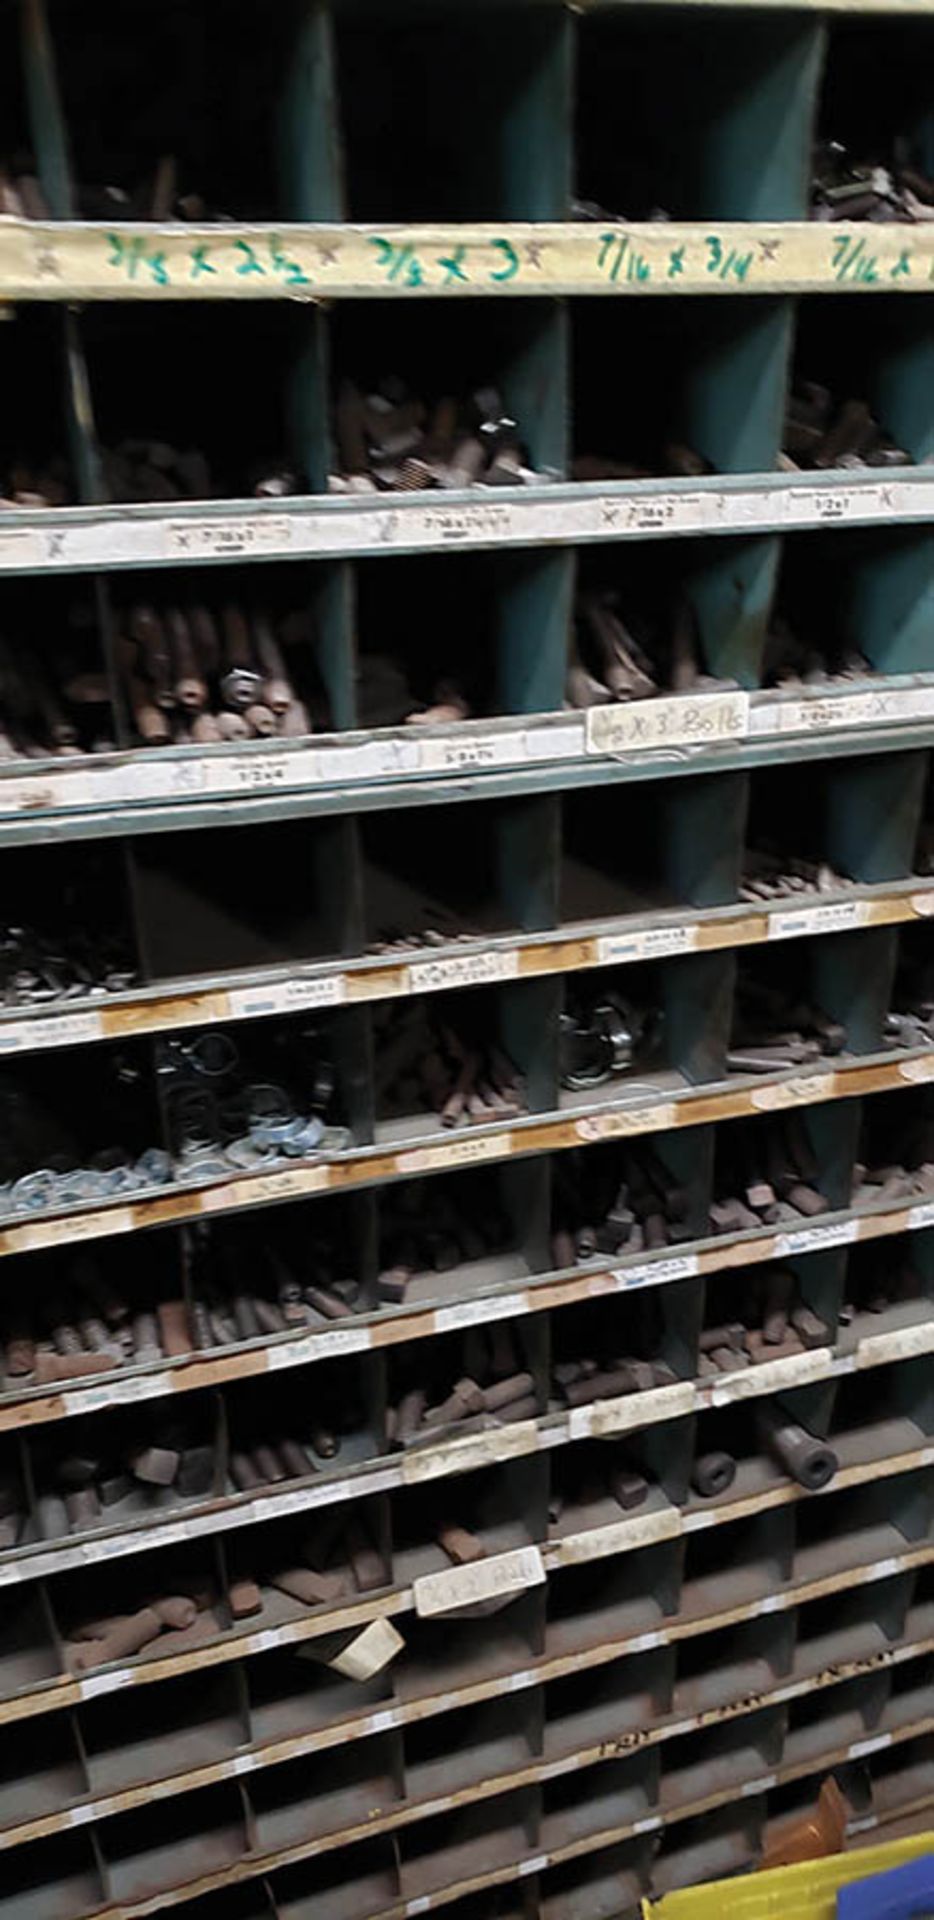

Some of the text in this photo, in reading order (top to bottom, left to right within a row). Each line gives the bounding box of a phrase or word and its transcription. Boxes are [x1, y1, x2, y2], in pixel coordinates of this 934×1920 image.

[489, 238, 519, 281] 3
[598, 233, 650, 281] 7/16
[705, 236, 753, 281] 3/4
[833, 235, 880, 282] 7/16
